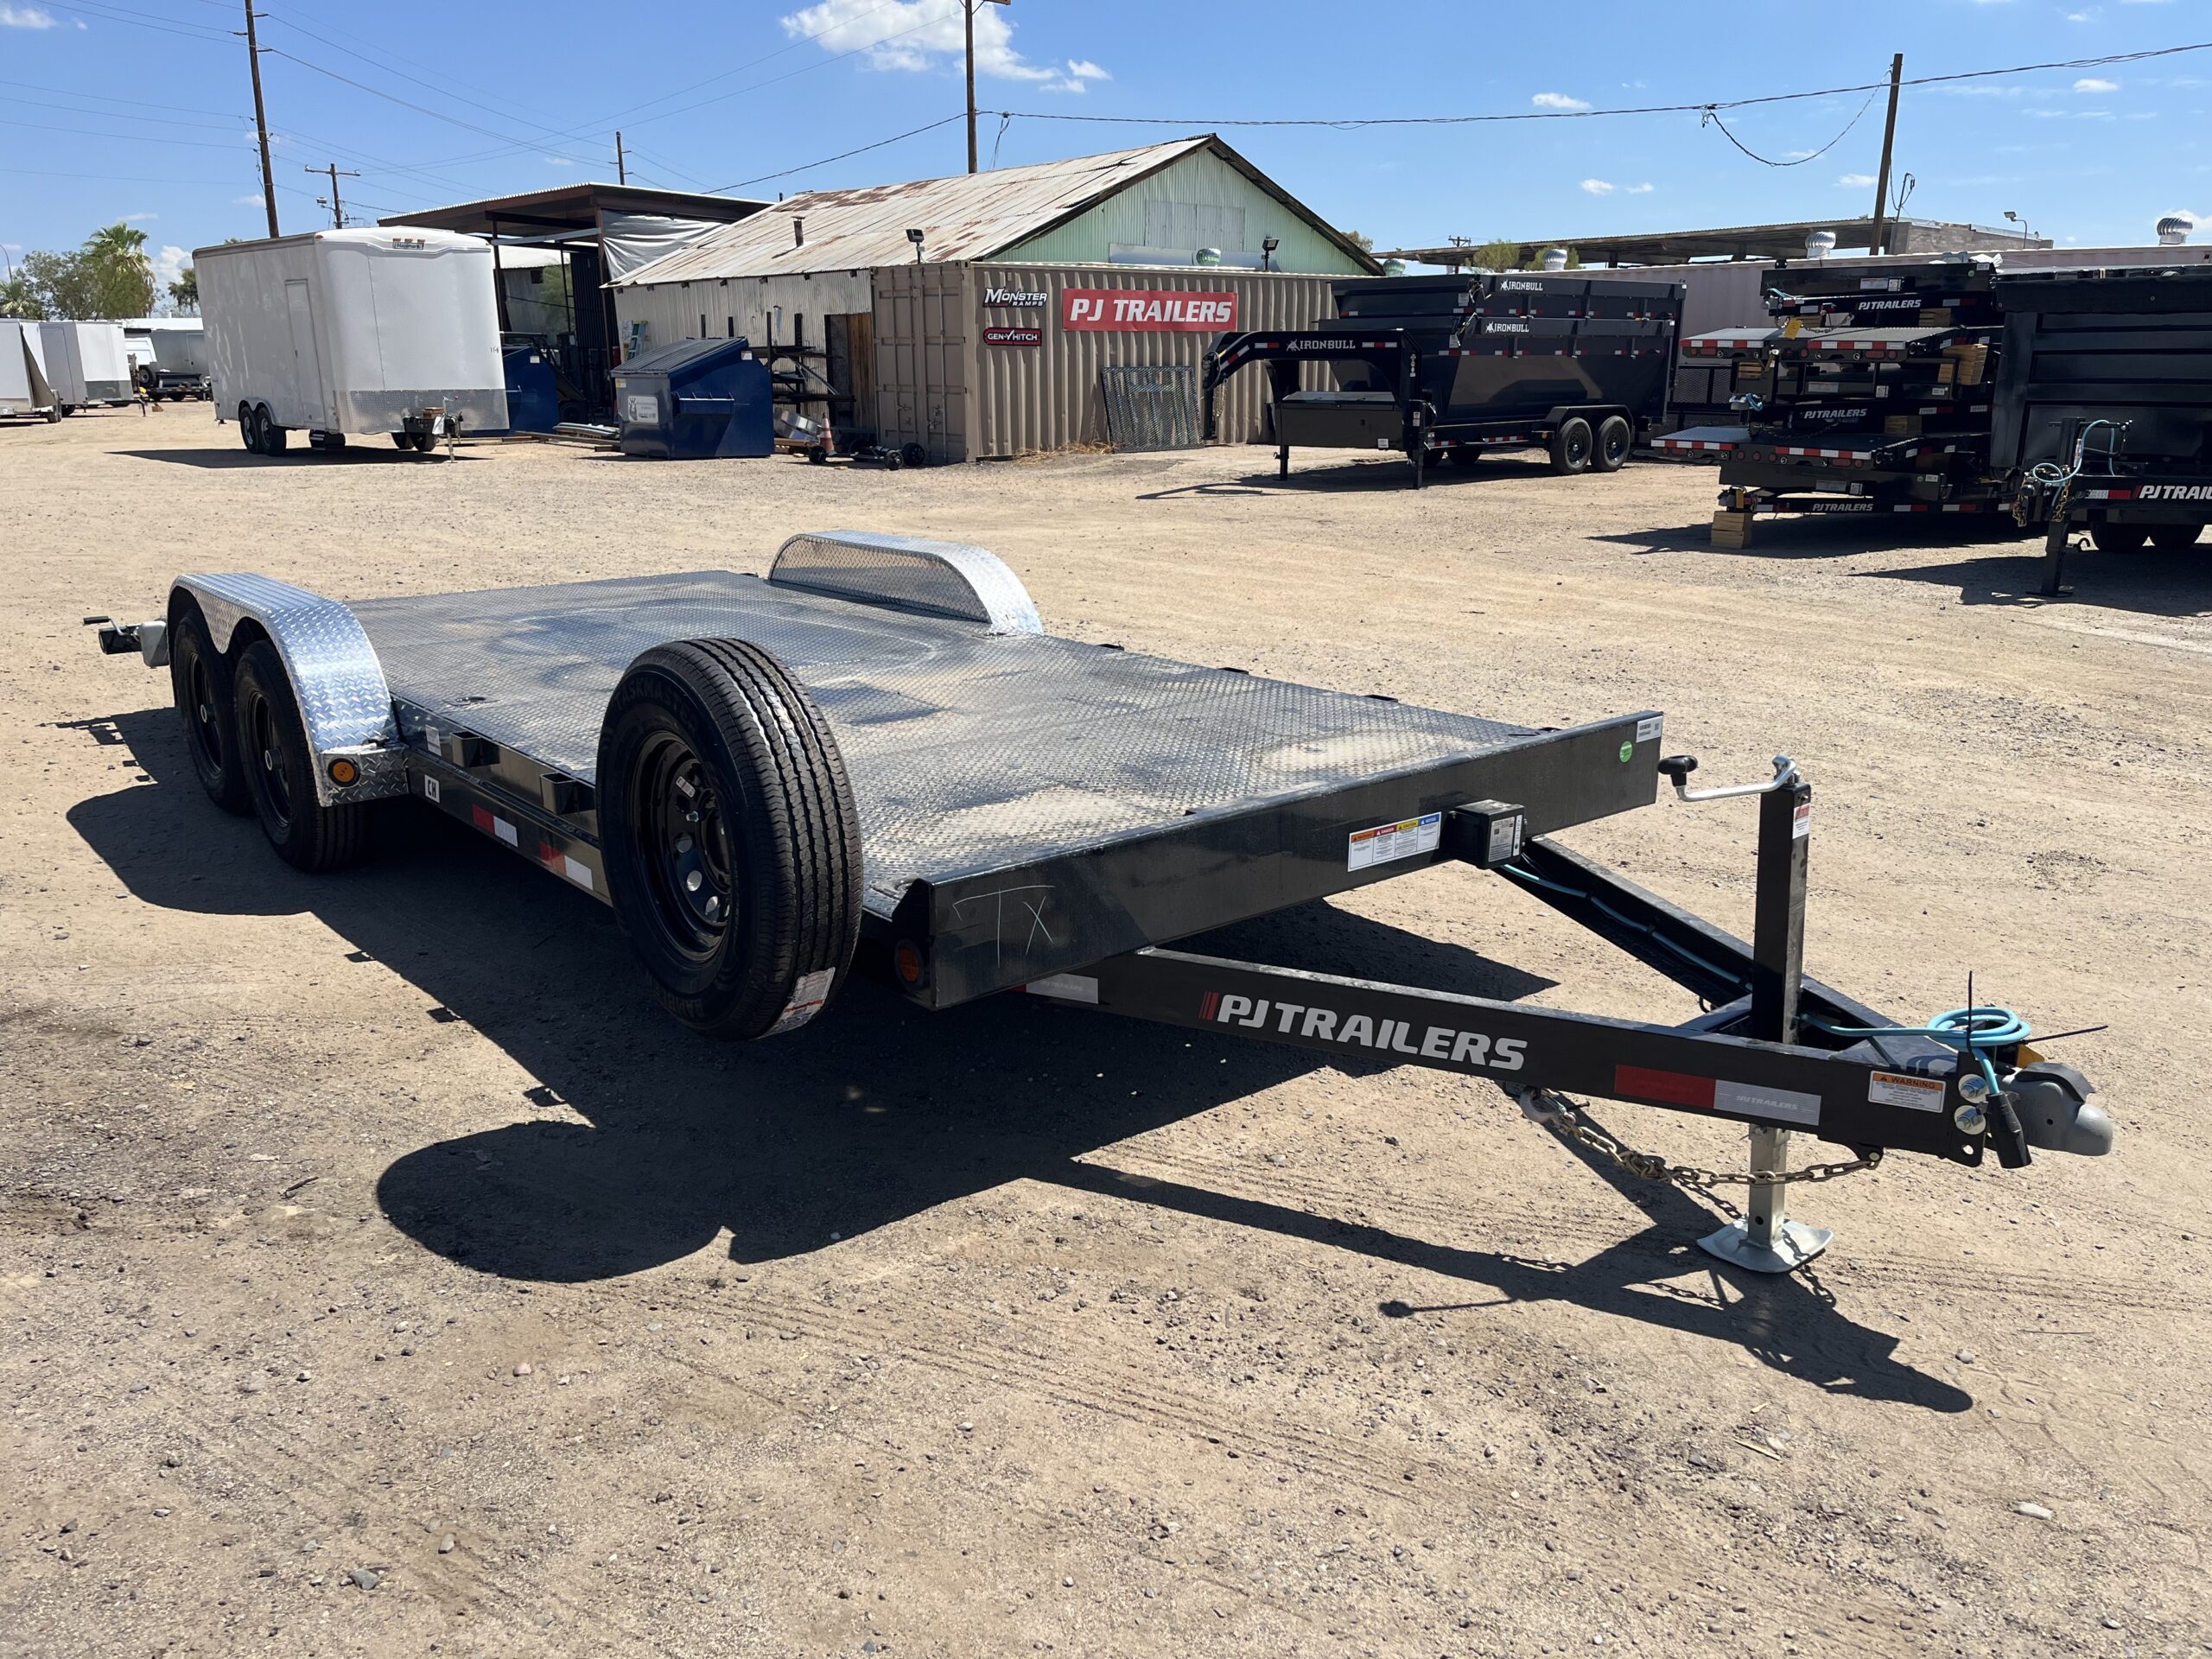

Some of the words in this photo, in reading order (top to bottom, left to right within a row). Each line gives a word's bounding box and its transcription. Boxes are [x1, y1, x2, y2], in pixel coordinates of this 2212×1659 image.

[1509, 281, 1543, 291] IRONBULL
[1858, 302, 1870, 311] PJ
[1870, 299, 1922, 310] TRAILERS
[1070, 299, 1103, 321] PJ
[1113, 299, 1232, 323] TRAILERS
[1494, 322, 1529, 333] IRONBULL
[1300, 340, 1356, 350] IRONBULL
[1804, 410, 1816, 419] PJ
[1816, 408, 1867, 418] TRAILERS
[2139, 485, 2162, 499] PJ
[1812, 503, 1823, 512] PJ
[1824, 503, 1873, 512] TRAILERS
[1217, 994, 1270, 1028] PJ
[1274, 1001, 1529, 1071] TRAILERS
[1891, 1077, 1936, 1089] WARNING
